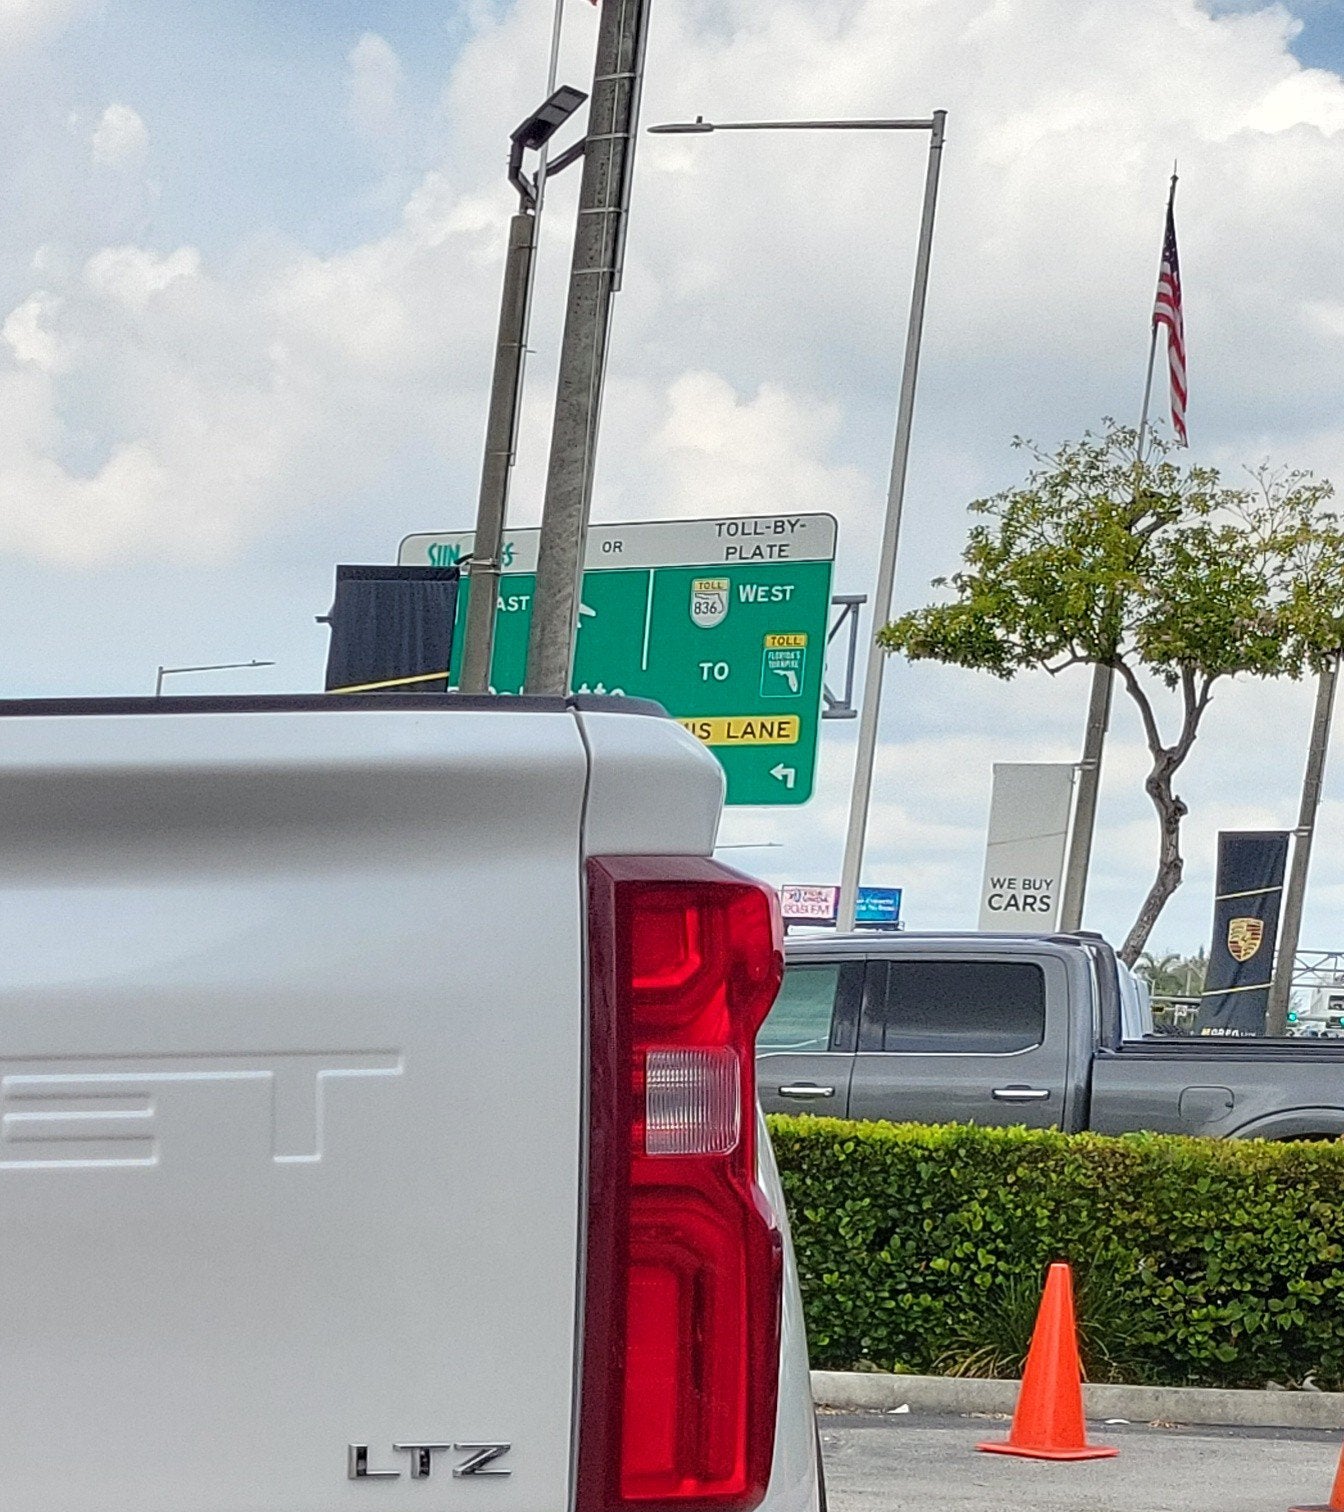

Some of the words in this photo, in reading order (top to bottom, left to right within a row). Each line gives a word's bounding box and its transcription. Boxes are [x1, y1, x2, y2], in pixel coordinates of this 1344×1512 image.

[715, 518, 807, 537] TOLL-BY-
[602, 541, 623, 553] OR
[725, 544, 790, 561] PLATE
[698, 581, 723, 590] TOLL
[739, 584, 794, 603] WEST
[496, 595, 530, 612] AST
[694, 601, 717, 615] 836
[771, 636, 801, 646] TOLL
[699, 662, 729, 681] TO
[726, 721, 791, 739] LANE
[991, 877, 1017, 890] WE
[1022, 878, 1053, 890] BUY
[988, 893, 1051, 912] CARS
[348, 1441, 512, 1479] LTZ
